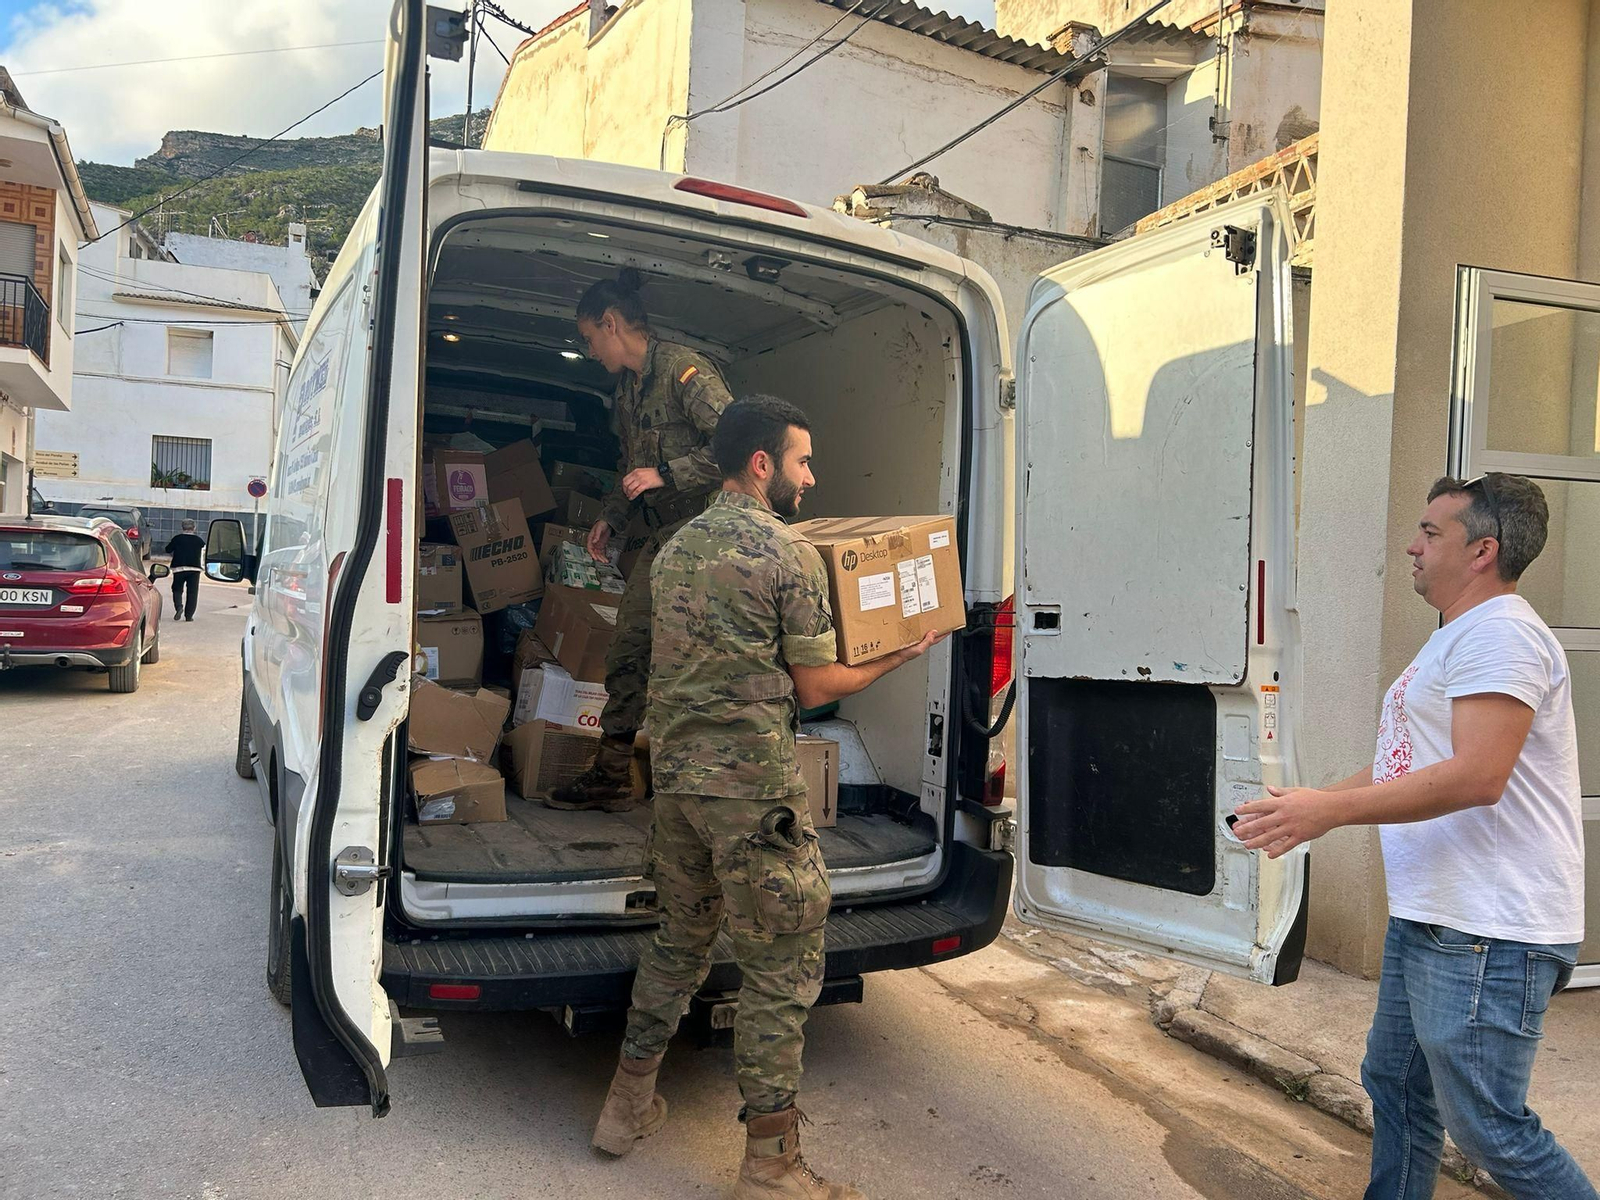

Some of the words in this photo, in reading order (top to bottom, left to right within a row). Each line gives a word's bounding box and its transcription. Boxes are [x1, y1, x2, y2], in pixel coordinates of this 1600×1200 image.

[481, 534, 525, 559] ECHO
[490, 551, 528, 568] PB-2520
[843, 549, 857, 571] hp
[860, 549, 888, 563] Desktop
[22, 591, 49, 603] KSN
[577, 714, 601, 728] CO
